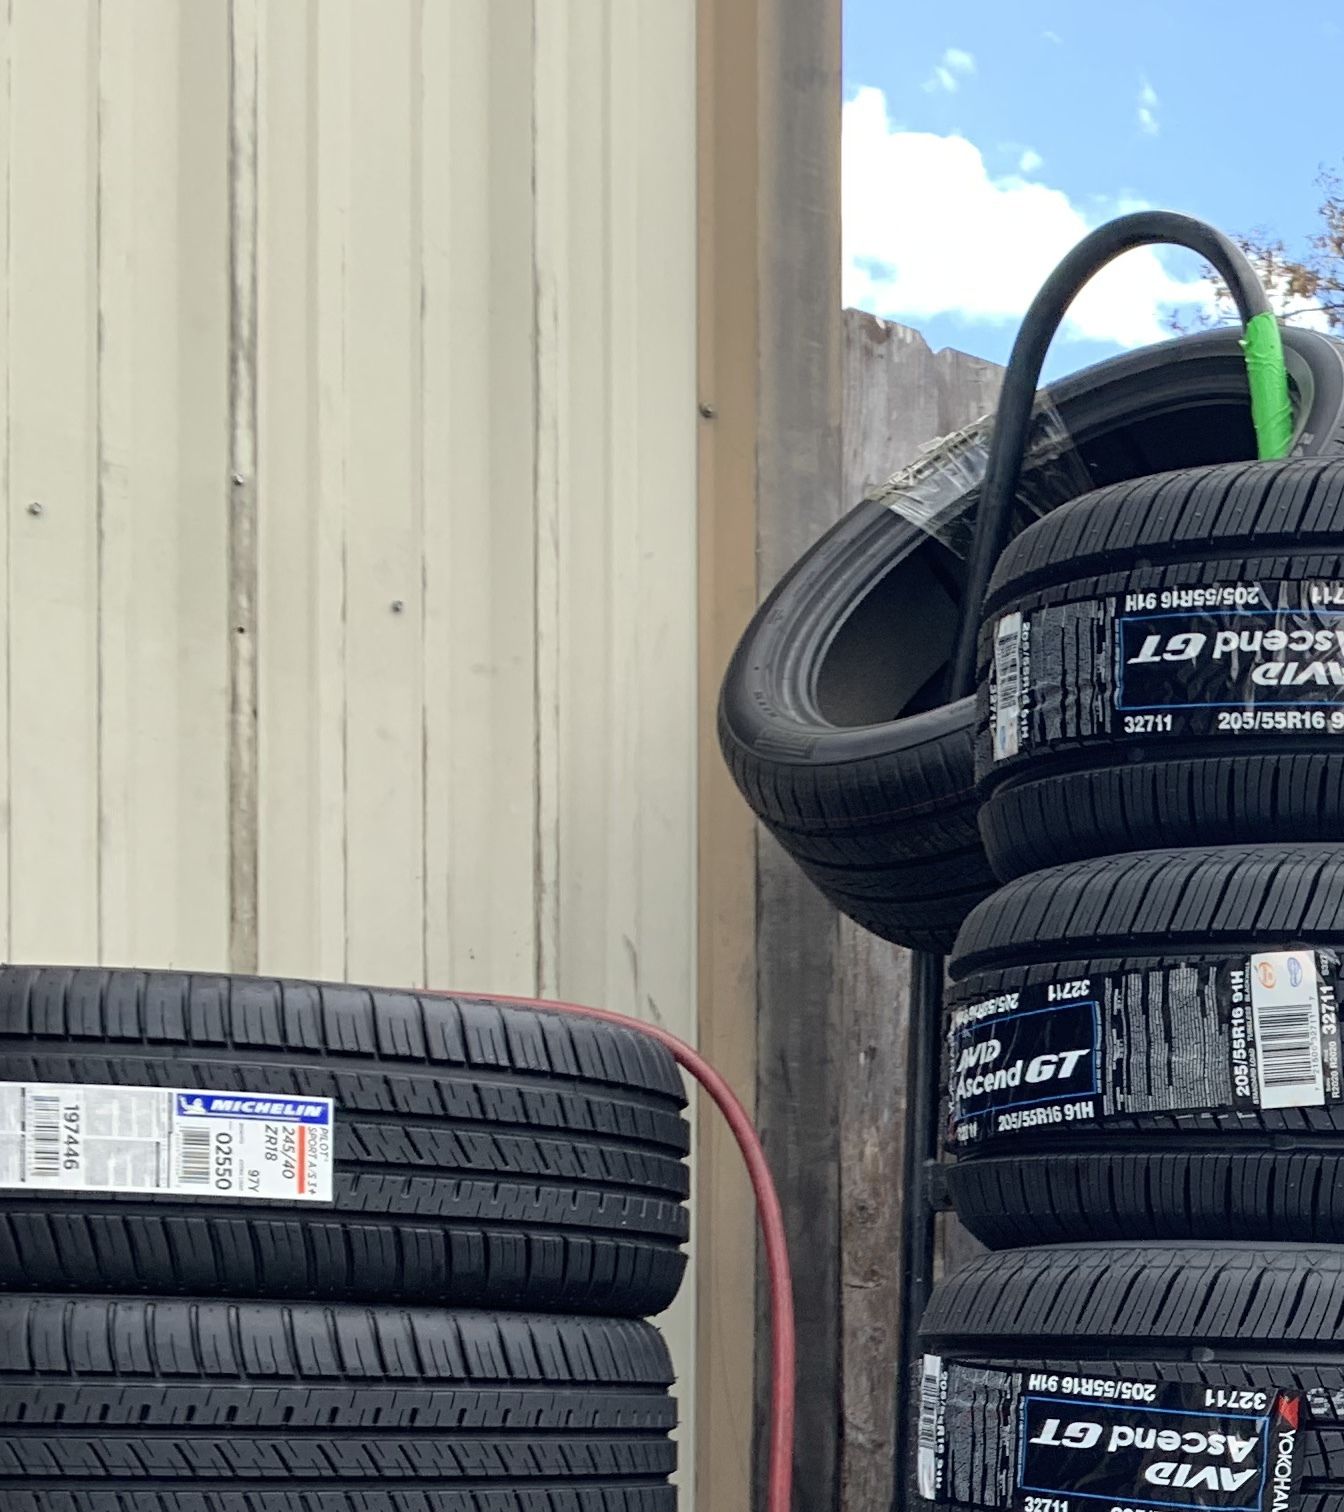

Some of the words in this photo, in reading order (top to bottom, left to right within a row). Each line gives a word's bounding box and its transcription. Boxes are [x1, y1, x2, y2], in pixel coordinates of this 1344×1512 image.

[1124, 593, 1157, 612] 91H
[1161, 587, 1260, 607] 205/55R16
[1127, 632, 1206, 664] GT
[1123, 714, 1172, 734] 32711
[1217, 711, 1325, 730] 205/55R16
[1047, 978, 1091, 1001] 32711
[1230, 970, 1245, 1002] 91H
[1319, 985, 1337, 1035] 32711
[956, 1039, 1001, 1074] AVID
[1231, 1006, 1251, 1098] 205/55R16
[956, 1061, 1020, 1101] Ascend
[1024, 1048, 1091, 1085] GT
[210, 1098, 323, 1118] MICHELIN
[997, 1109, 1063, 1132] 205/55R16
[1063, 1101, 1094, 1121] 91H
[63, 1103, 81, 1171] 197446
[264, 1124, 279, 1162] ZR18
[281, 1125, 296, 1180] 245/40
[307, 1126, 318, 1159] SPORT
[319, 1127, 329, 1158] PILOT
[215, 1131, 233, 1191] 02550
[248, 1168, 261, 1193] 97Y
[1028, 1374, 1058, 1391] 91H
[1061, 1374, 1156, 1402] 205/55R16
[1204, 1388, 1267, 1410] 32711
[1030, 1418, 1102, 1448] GT
[1108, 1425, 1259, 1464] Ascend
[1145, 1461, 1259, 1492] AVID
